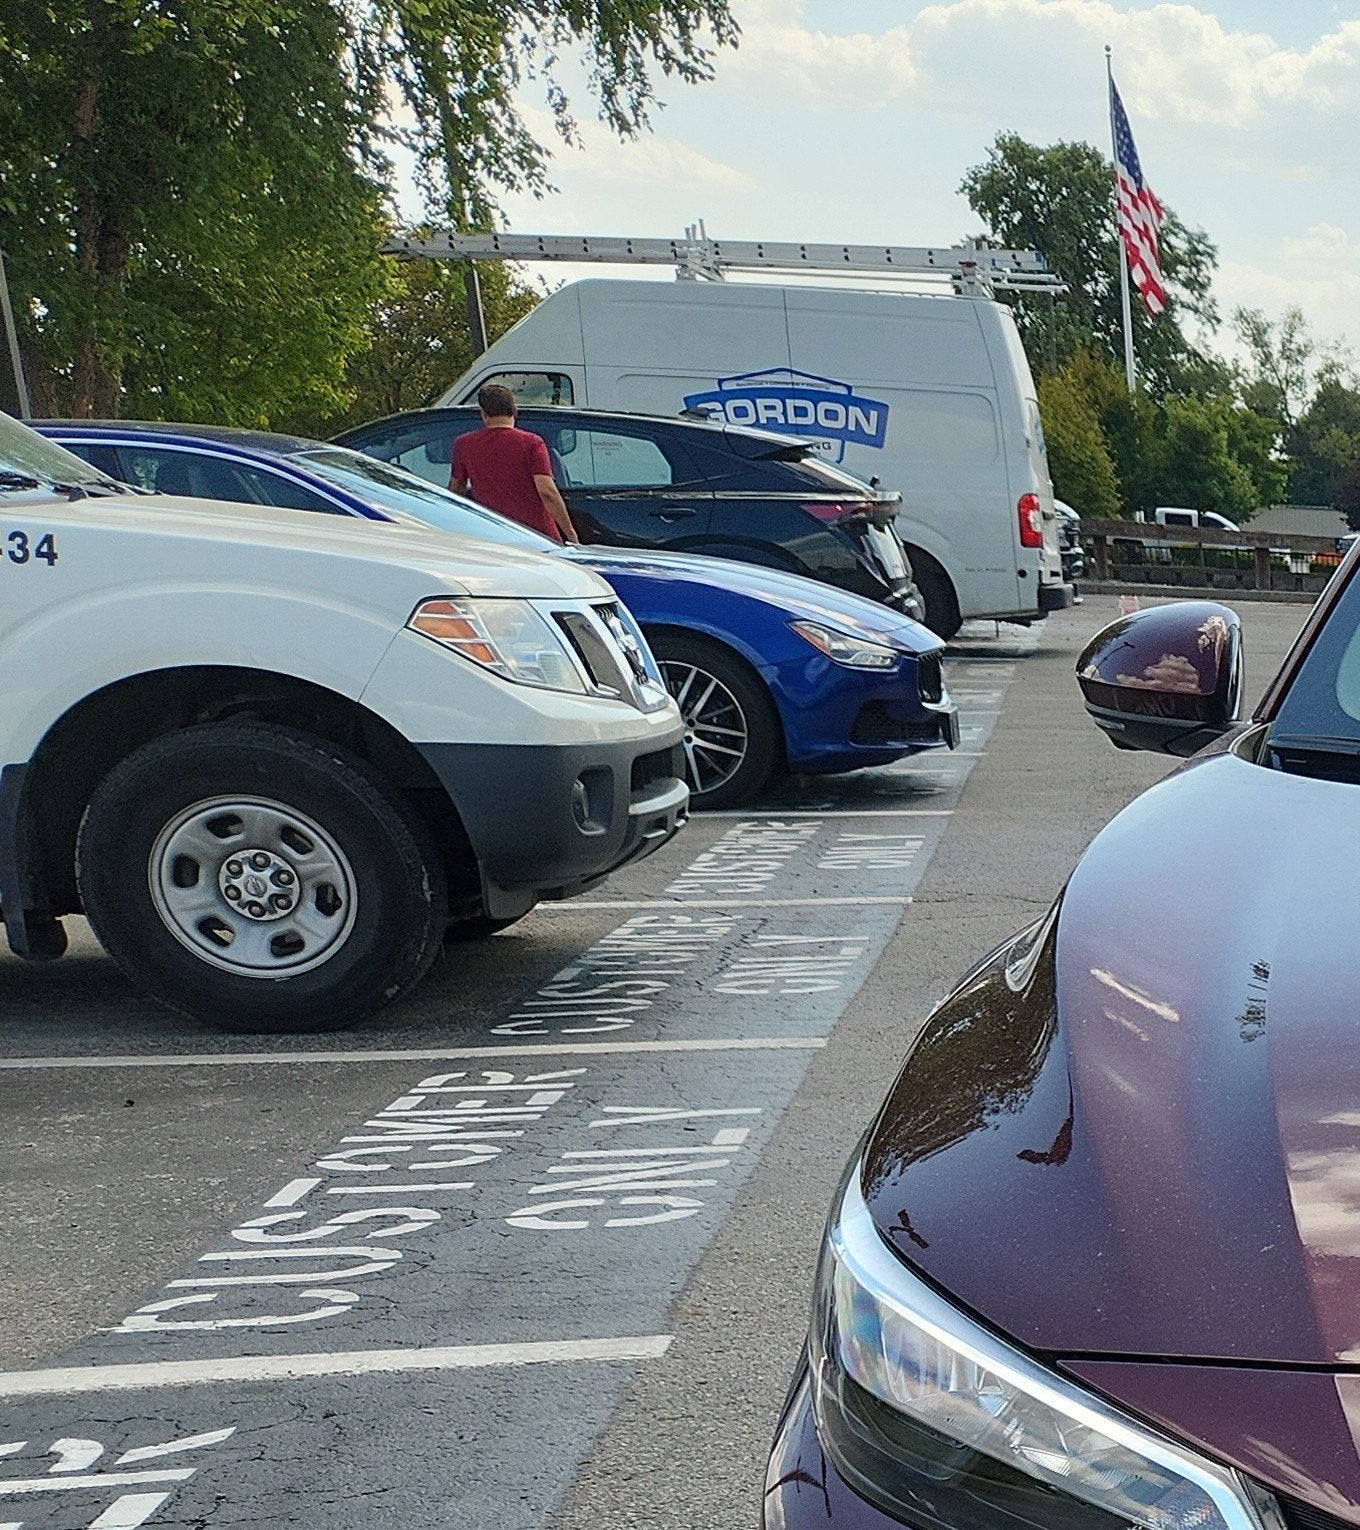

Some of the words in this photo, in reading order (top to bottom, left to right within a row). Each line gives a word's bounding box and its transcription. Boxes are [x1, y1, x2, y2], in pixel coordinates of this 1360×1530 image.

[696, 397, 879, 436] GORDON
[0, 530, 59, 567] 34
[816, 833, 926, 870] ONLY
[489, 914, 743, 1036] CUSTOMER
[712, 934, 870, 995] ONLY
[505, 1107, 764, 1231] ONLY
[118, 1068, 588, 1332] CUSTOMER
